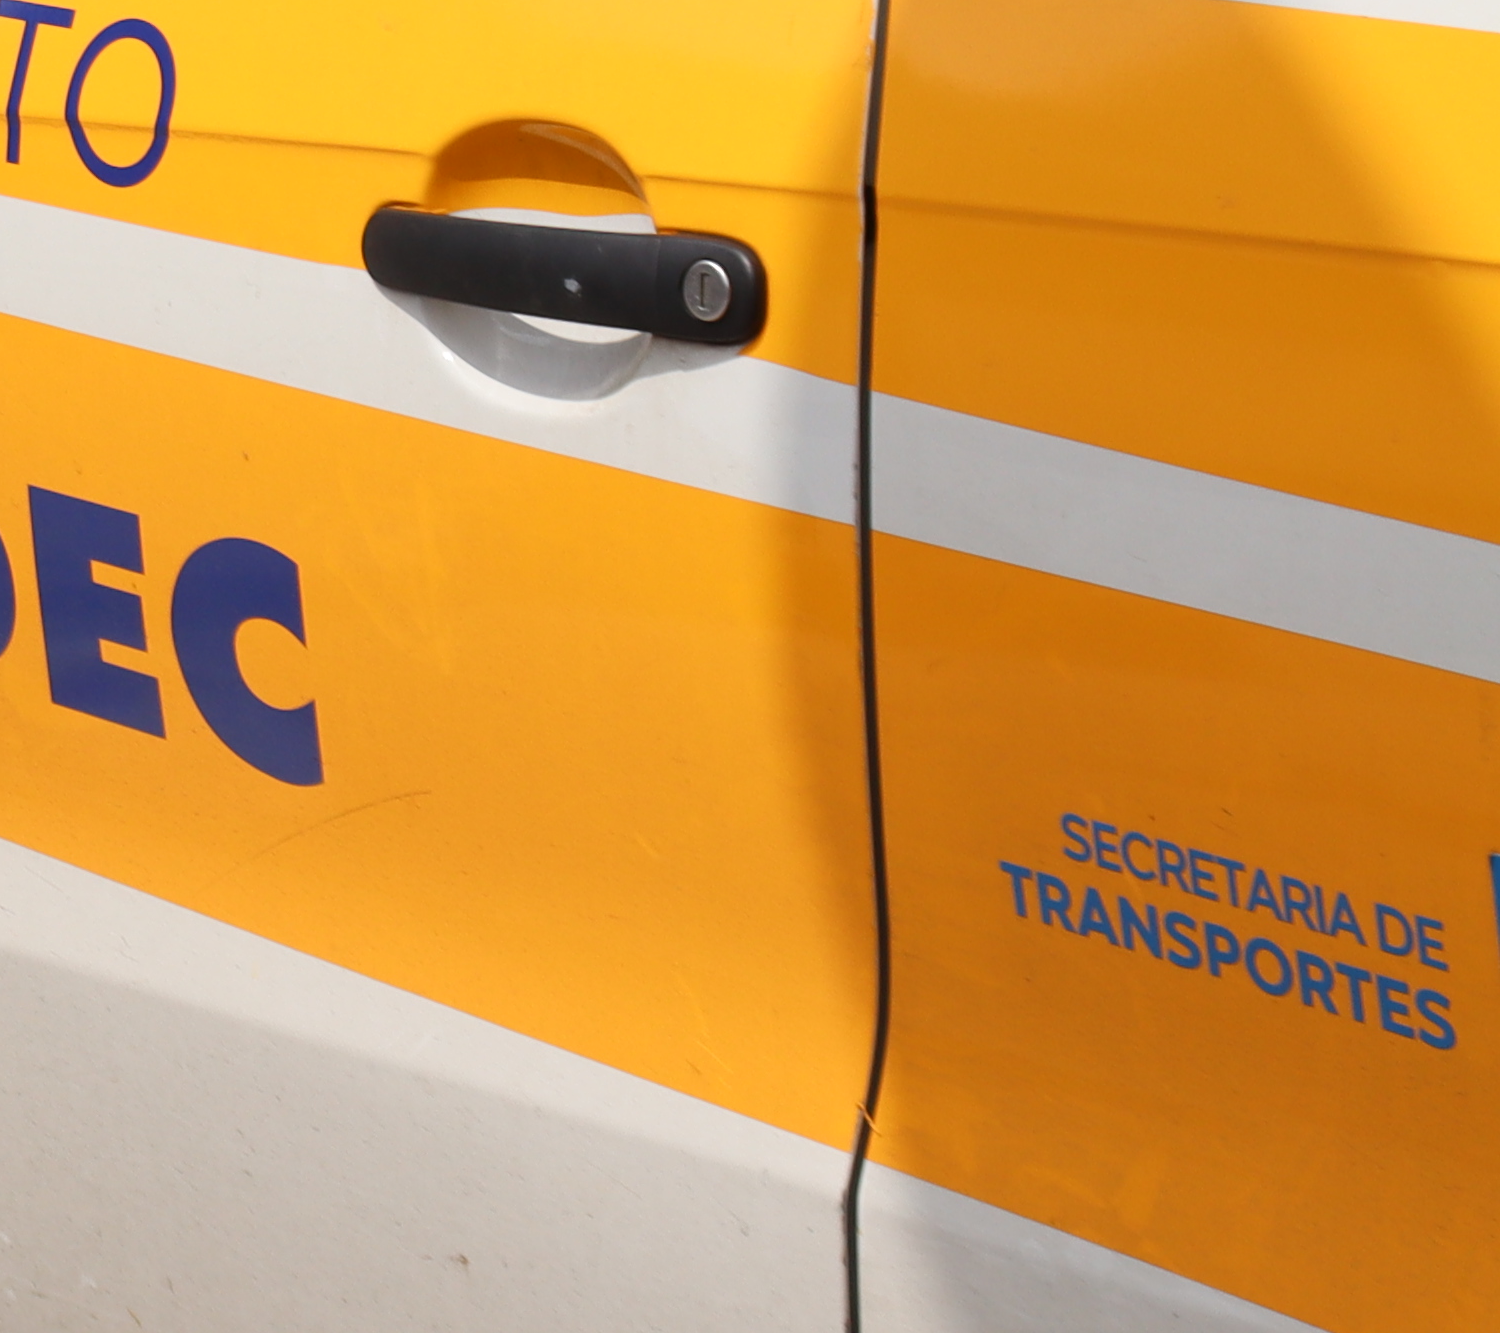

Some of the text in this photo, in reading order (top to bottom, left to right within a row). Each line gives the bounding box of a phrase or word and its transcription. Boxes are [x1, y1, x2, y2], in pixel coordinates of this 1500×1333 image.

[999, 860, 1458, 1052] TRANSPORTES
[1060, 812, 1451, 973] SECRETARIA DE
